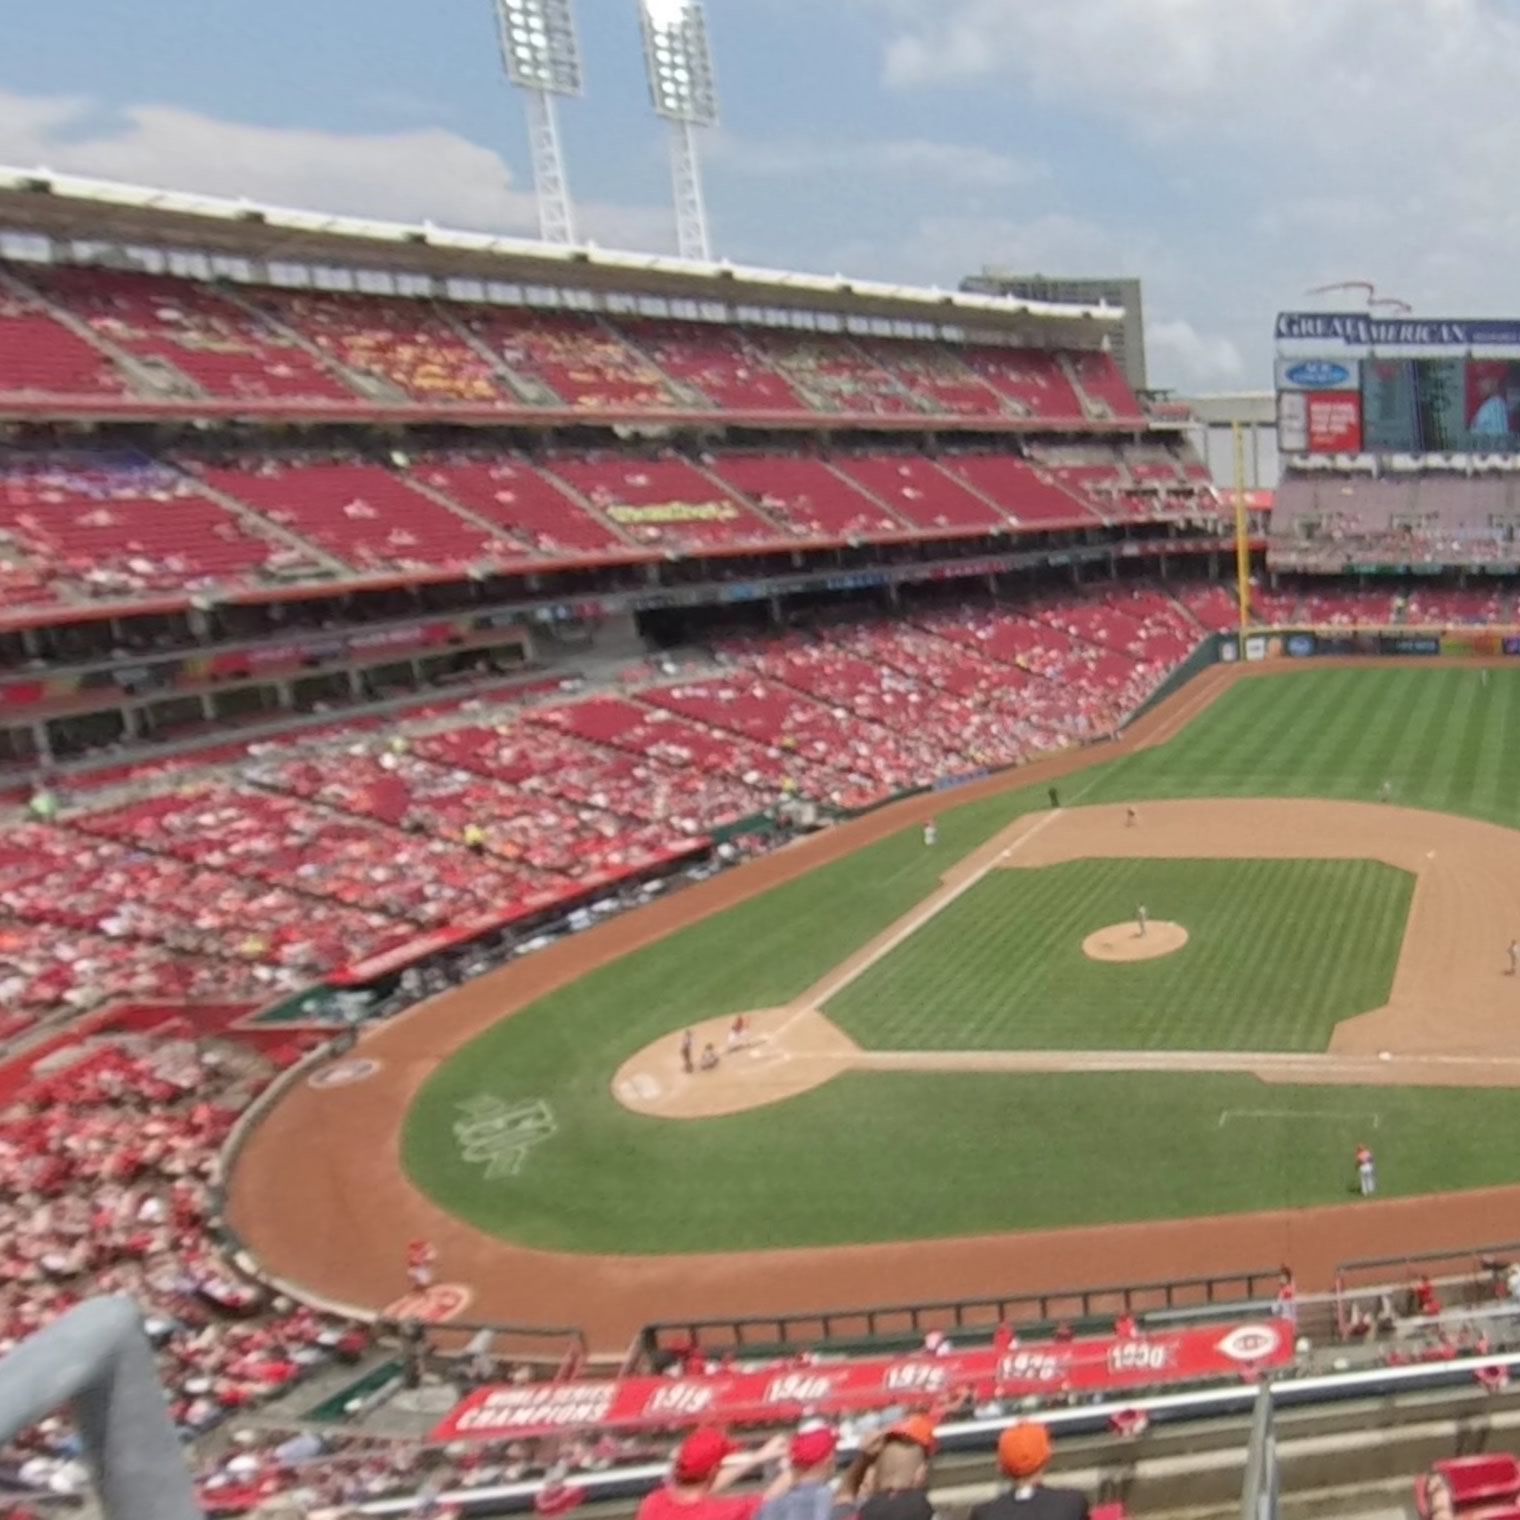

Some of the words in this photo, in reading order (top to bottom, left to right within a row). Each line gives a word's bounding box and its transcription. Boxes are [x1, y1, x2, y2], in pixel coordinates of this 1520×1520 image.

[1278, 313, 1356, 338] GREAT
[1355, 318, 1466, 344] AMERICAN
[455, 1401, 612, 1430] CHAMPIONS
